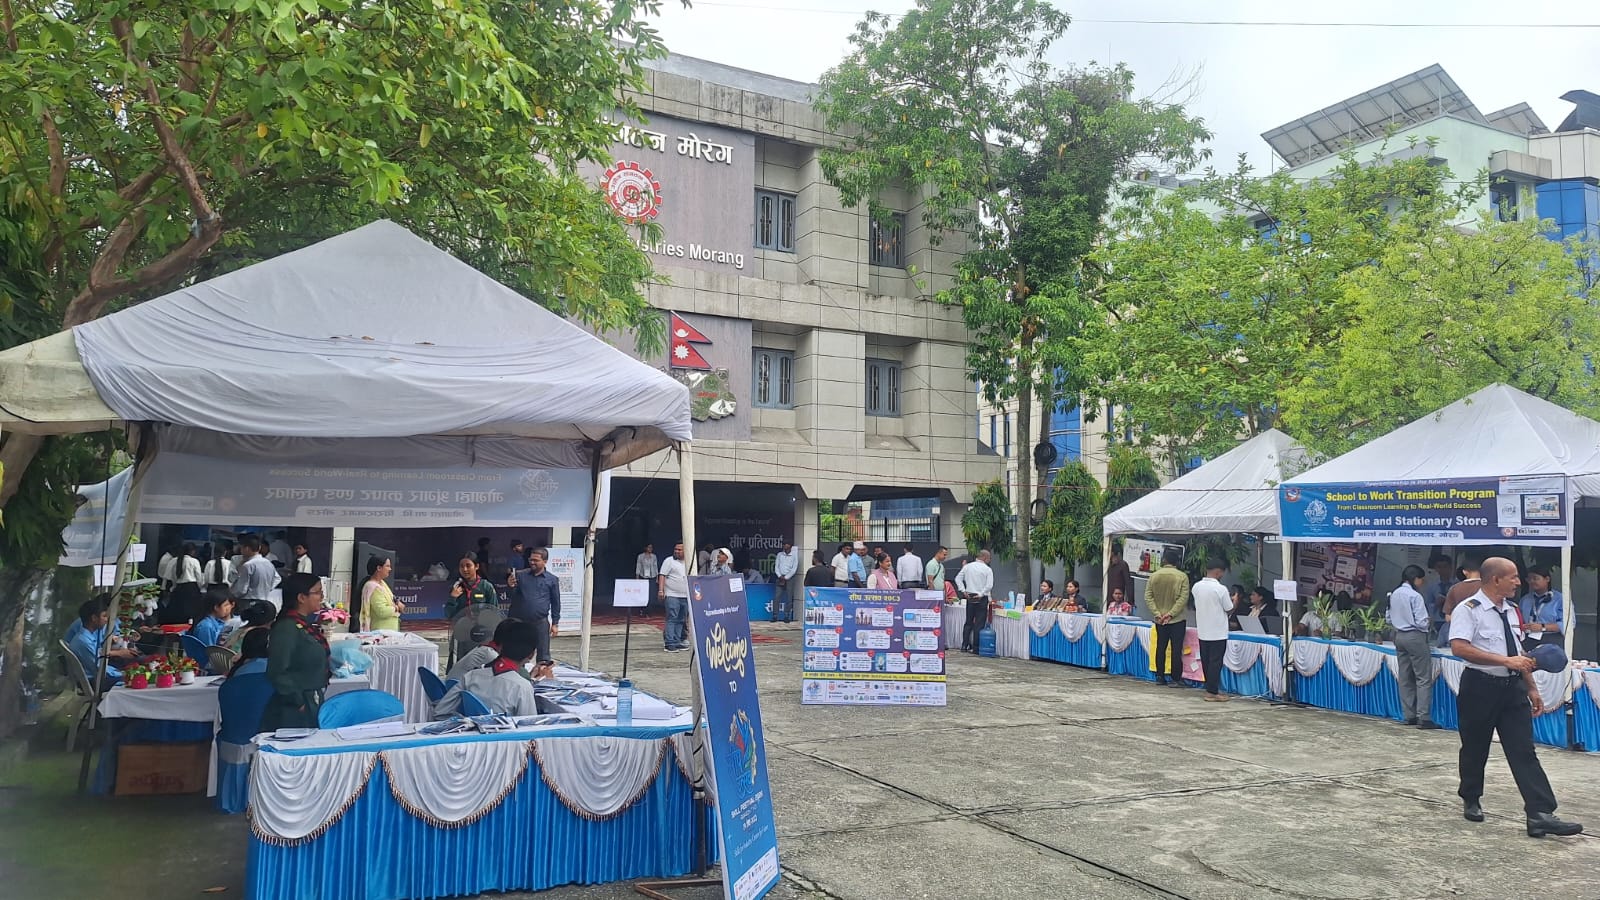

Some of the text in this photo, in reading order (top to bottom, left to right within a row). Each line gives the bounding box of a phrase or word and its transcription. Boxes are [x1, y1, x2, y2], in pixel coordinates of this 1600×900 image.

[676, 133, 734, 164] मोरंग
[690, 243, 744, 269] Morang
[1326, 488, 1496, 502] School to Work Transition Program
[1352, 503, 1382, 511] Classroom
[1384, 503, 1409, 512] Learning
[1333, 516, 1371, 528] Sparkle
[1373, 516, 1392, 526] and
[1395, 516, 1453, 528] Stationary
[1455, 515, 1488, 526] Store
[705, 622, 747, 678] Welcome
[729, 680, 738, 693] TO
